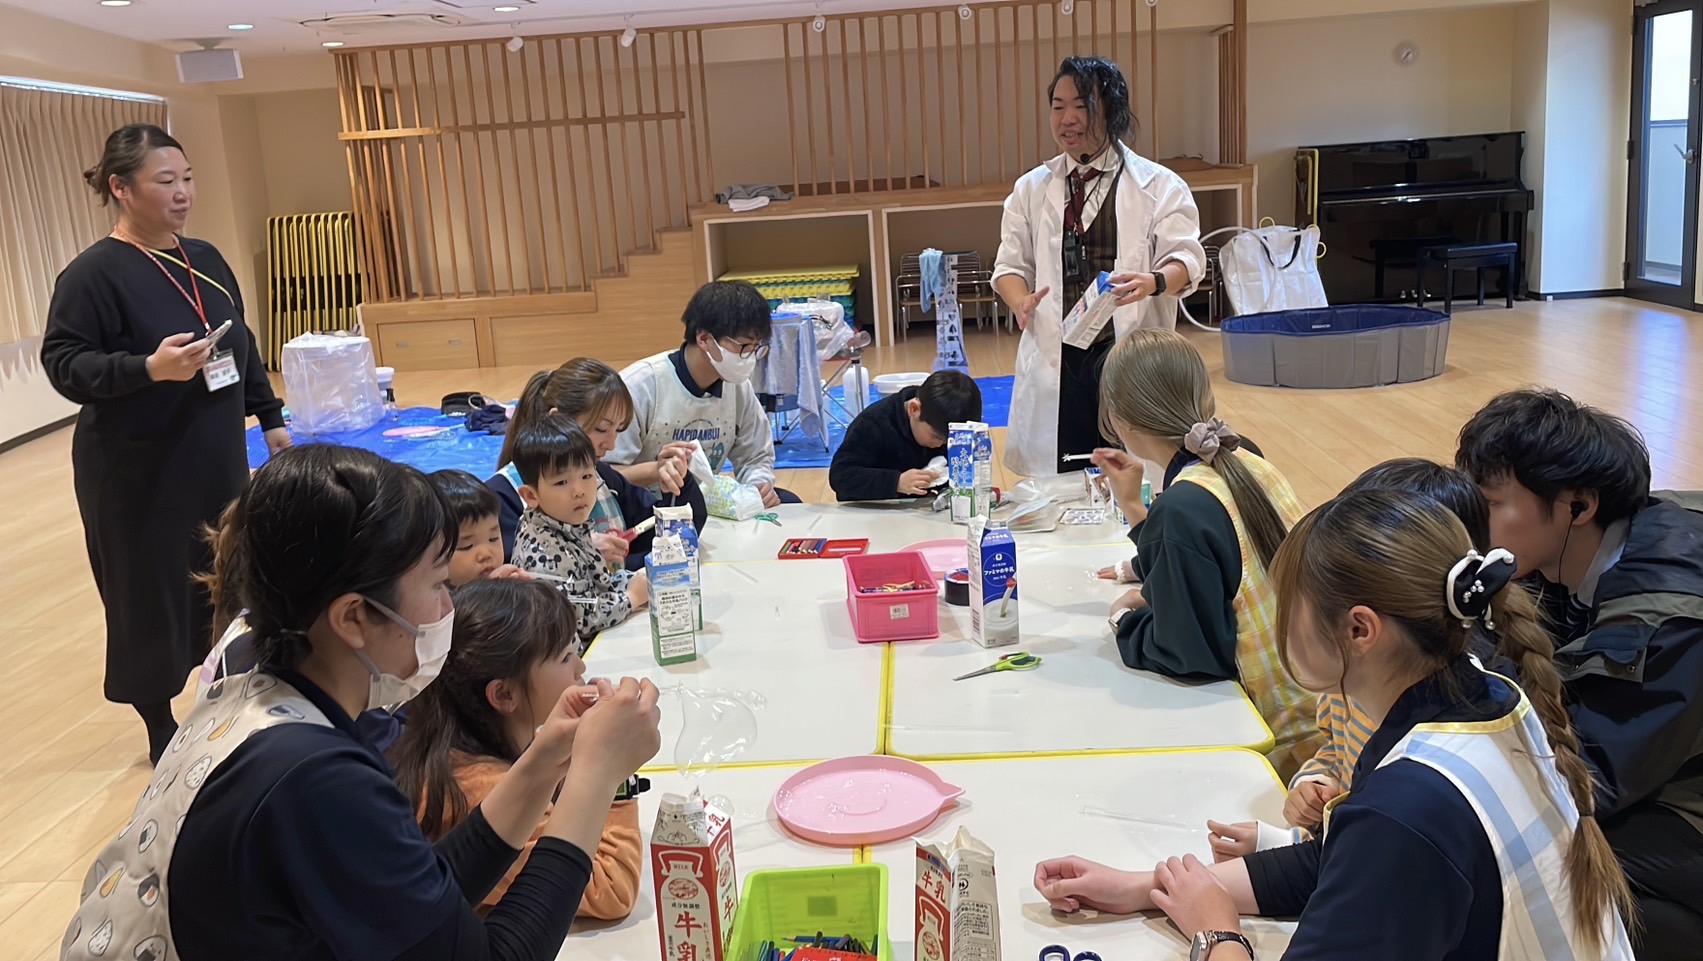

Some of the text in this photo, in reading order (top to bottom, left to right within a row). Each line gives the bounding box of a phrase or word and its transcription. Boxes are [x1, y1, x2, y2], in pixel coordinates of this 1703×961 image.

[983, 566, 1015, 576] ファミマの牛乳
[921, 869, 946, 904] 牛乳
[673, 910, 703, 961] 牛乳
